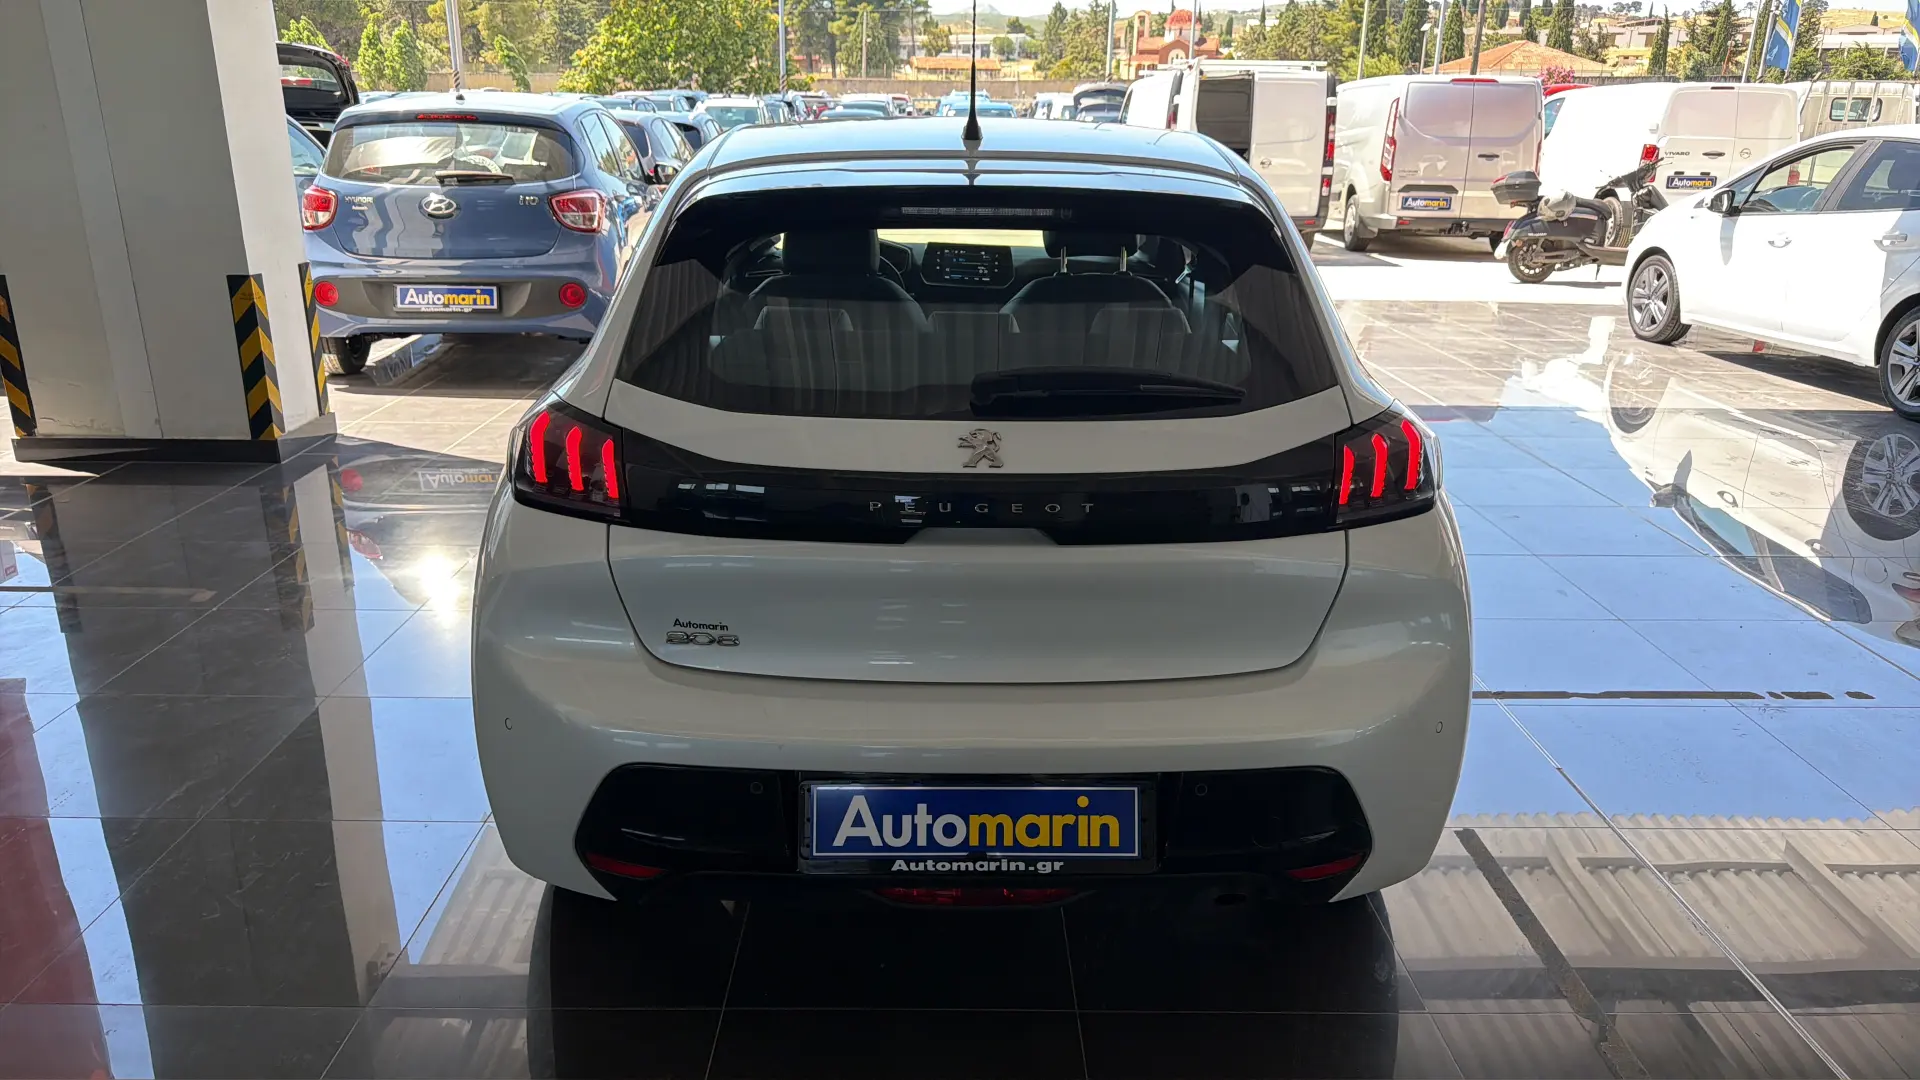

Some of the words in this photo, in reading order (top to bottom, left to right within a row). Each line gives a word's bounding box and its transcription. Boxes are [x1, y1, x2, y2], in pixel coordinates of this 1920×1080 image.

[1671, 177, 1713, 187] Automarin
[1405, 197, 1448, 208] Automarin
[404, 288, 491, 305] Automarin
[869, 501, 1094, 513] PEUGEOT
[672, 618, 729, 632] Automarin
[832, 795, 1120, 847] Automarin
[890, 858, 1065, 874] Automarin.gr
